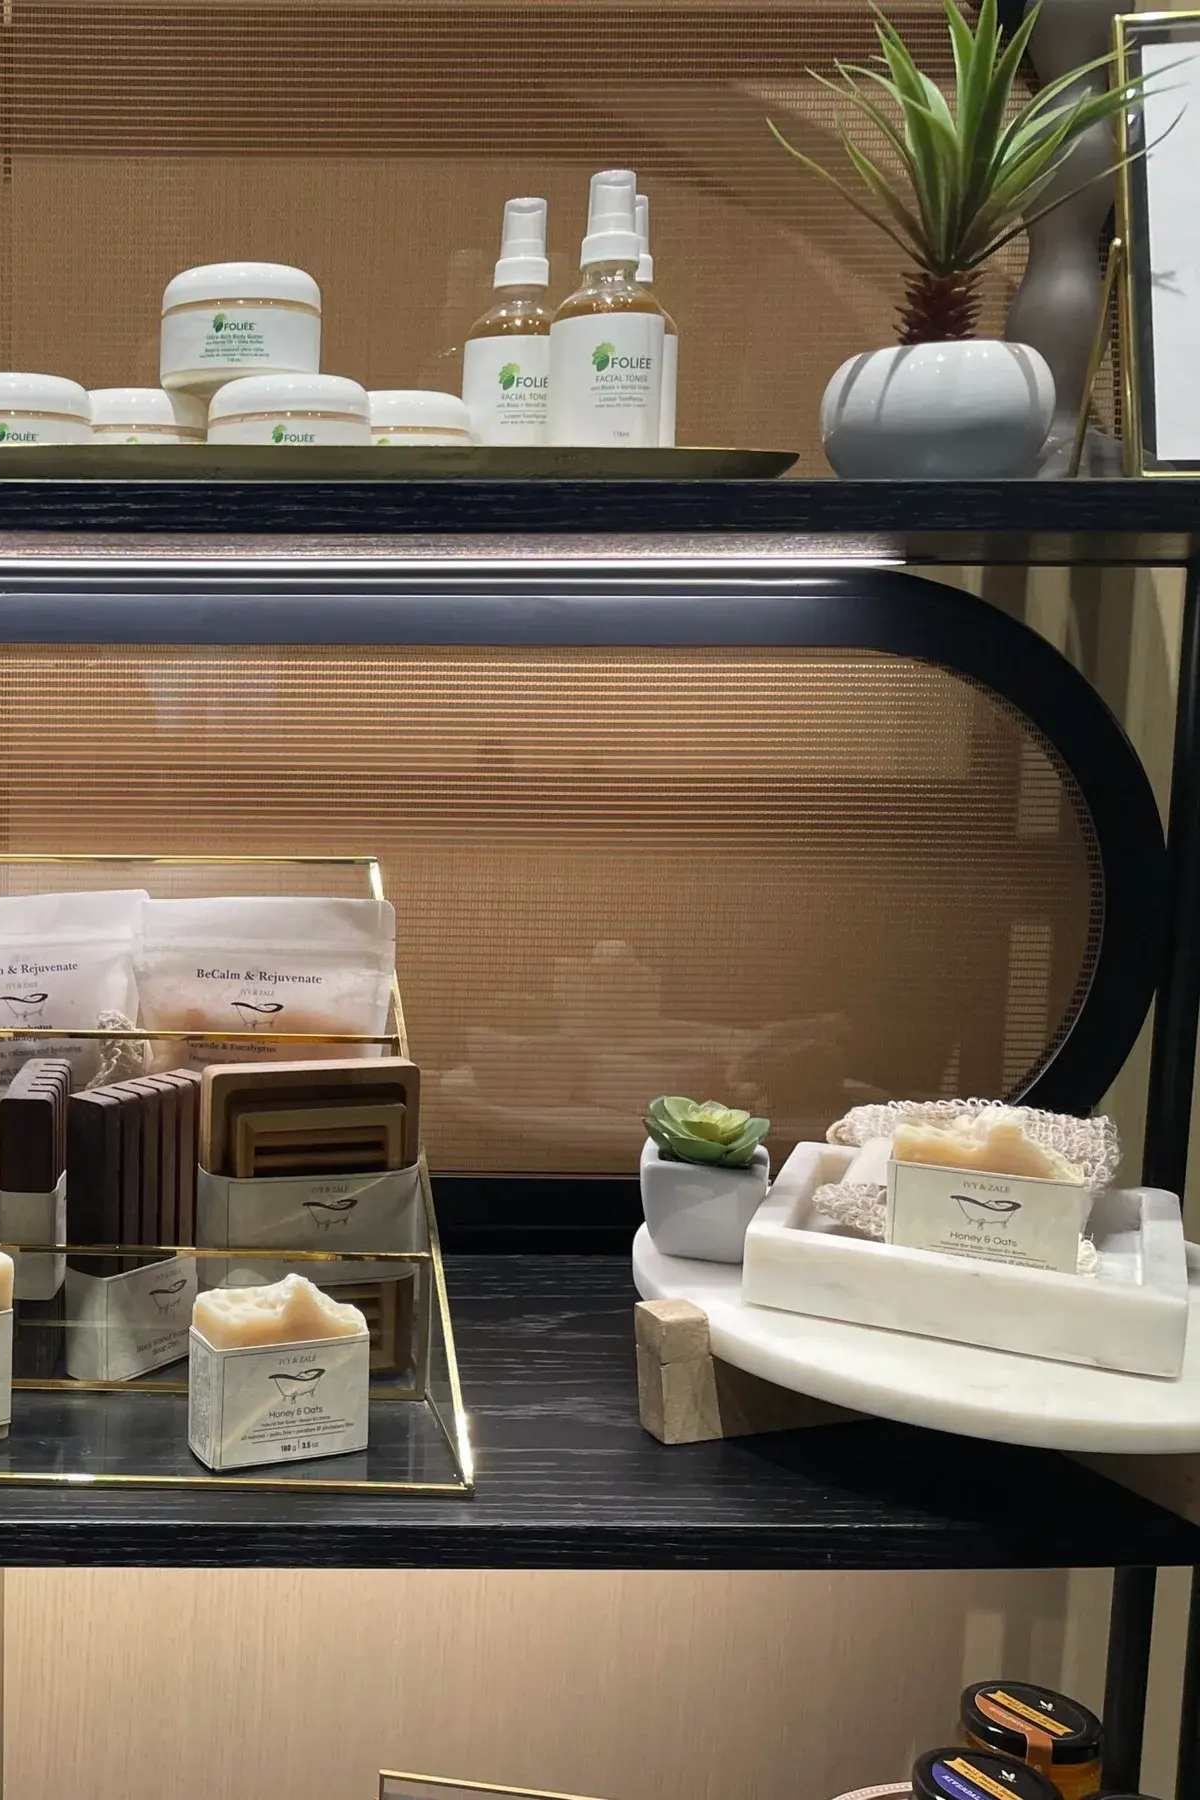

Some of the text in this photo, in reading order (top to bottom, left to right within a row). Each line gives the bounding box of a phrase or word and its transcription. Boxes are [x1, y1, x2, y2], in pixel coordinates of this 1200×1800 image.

[224, 321, 255, 331] FOLIÉE
[611, 354, 651, 370] FOLIÉE
[516, 375, 548, 388] FOLIÉ
[596, 375, 624, 383] FACIAL
[501, 392, 527, 401] FACIAL
[6, 431, 37, 442] FOLIÉE
[284, 432, 315, 443] FOLIÉE
[7, 964, 18, 975] &
[21, 962, 79, 976] Rejuvenate
[197, 968, 323, 984] BeCalm & Rejuvenate
[963, 1181, 1012, 1193] IVY & ZALE
[950, 1231, 1018, 1247] Honey & Oats
[279, 1357, 290, 1365] IVY
[299, 1355, 317, 1364] ZALE
[269, 1409, 295, 1419] Honey
[303, 1406, 323, 1415] Oats
[941, 1774, 983, 1800] RIVERDAL
